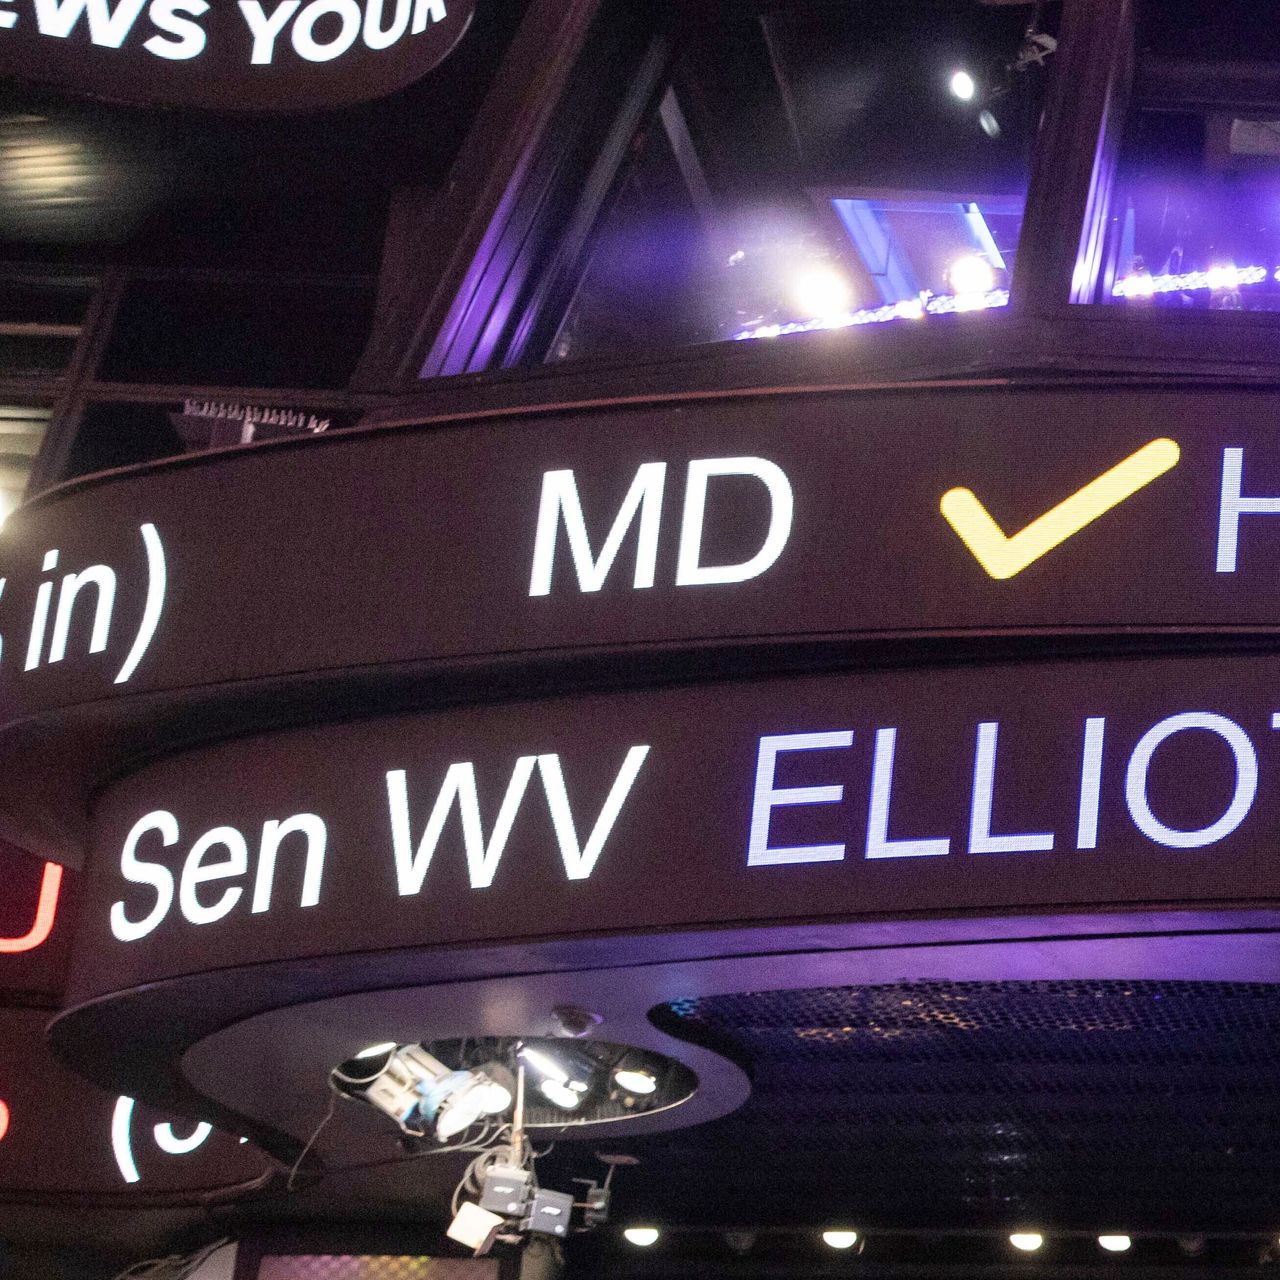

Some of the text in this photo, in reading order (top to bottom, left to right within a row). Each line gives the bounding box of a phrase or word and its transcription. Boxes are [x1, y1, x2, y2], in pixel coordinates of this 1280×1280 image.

[0, 0, 208, 60] WS
[529, 457, 793, 597] MD
[23, 523, 166, 684] in)
[110, 810, 327, 942] Sen
[386, 745, 650, 896] WV
